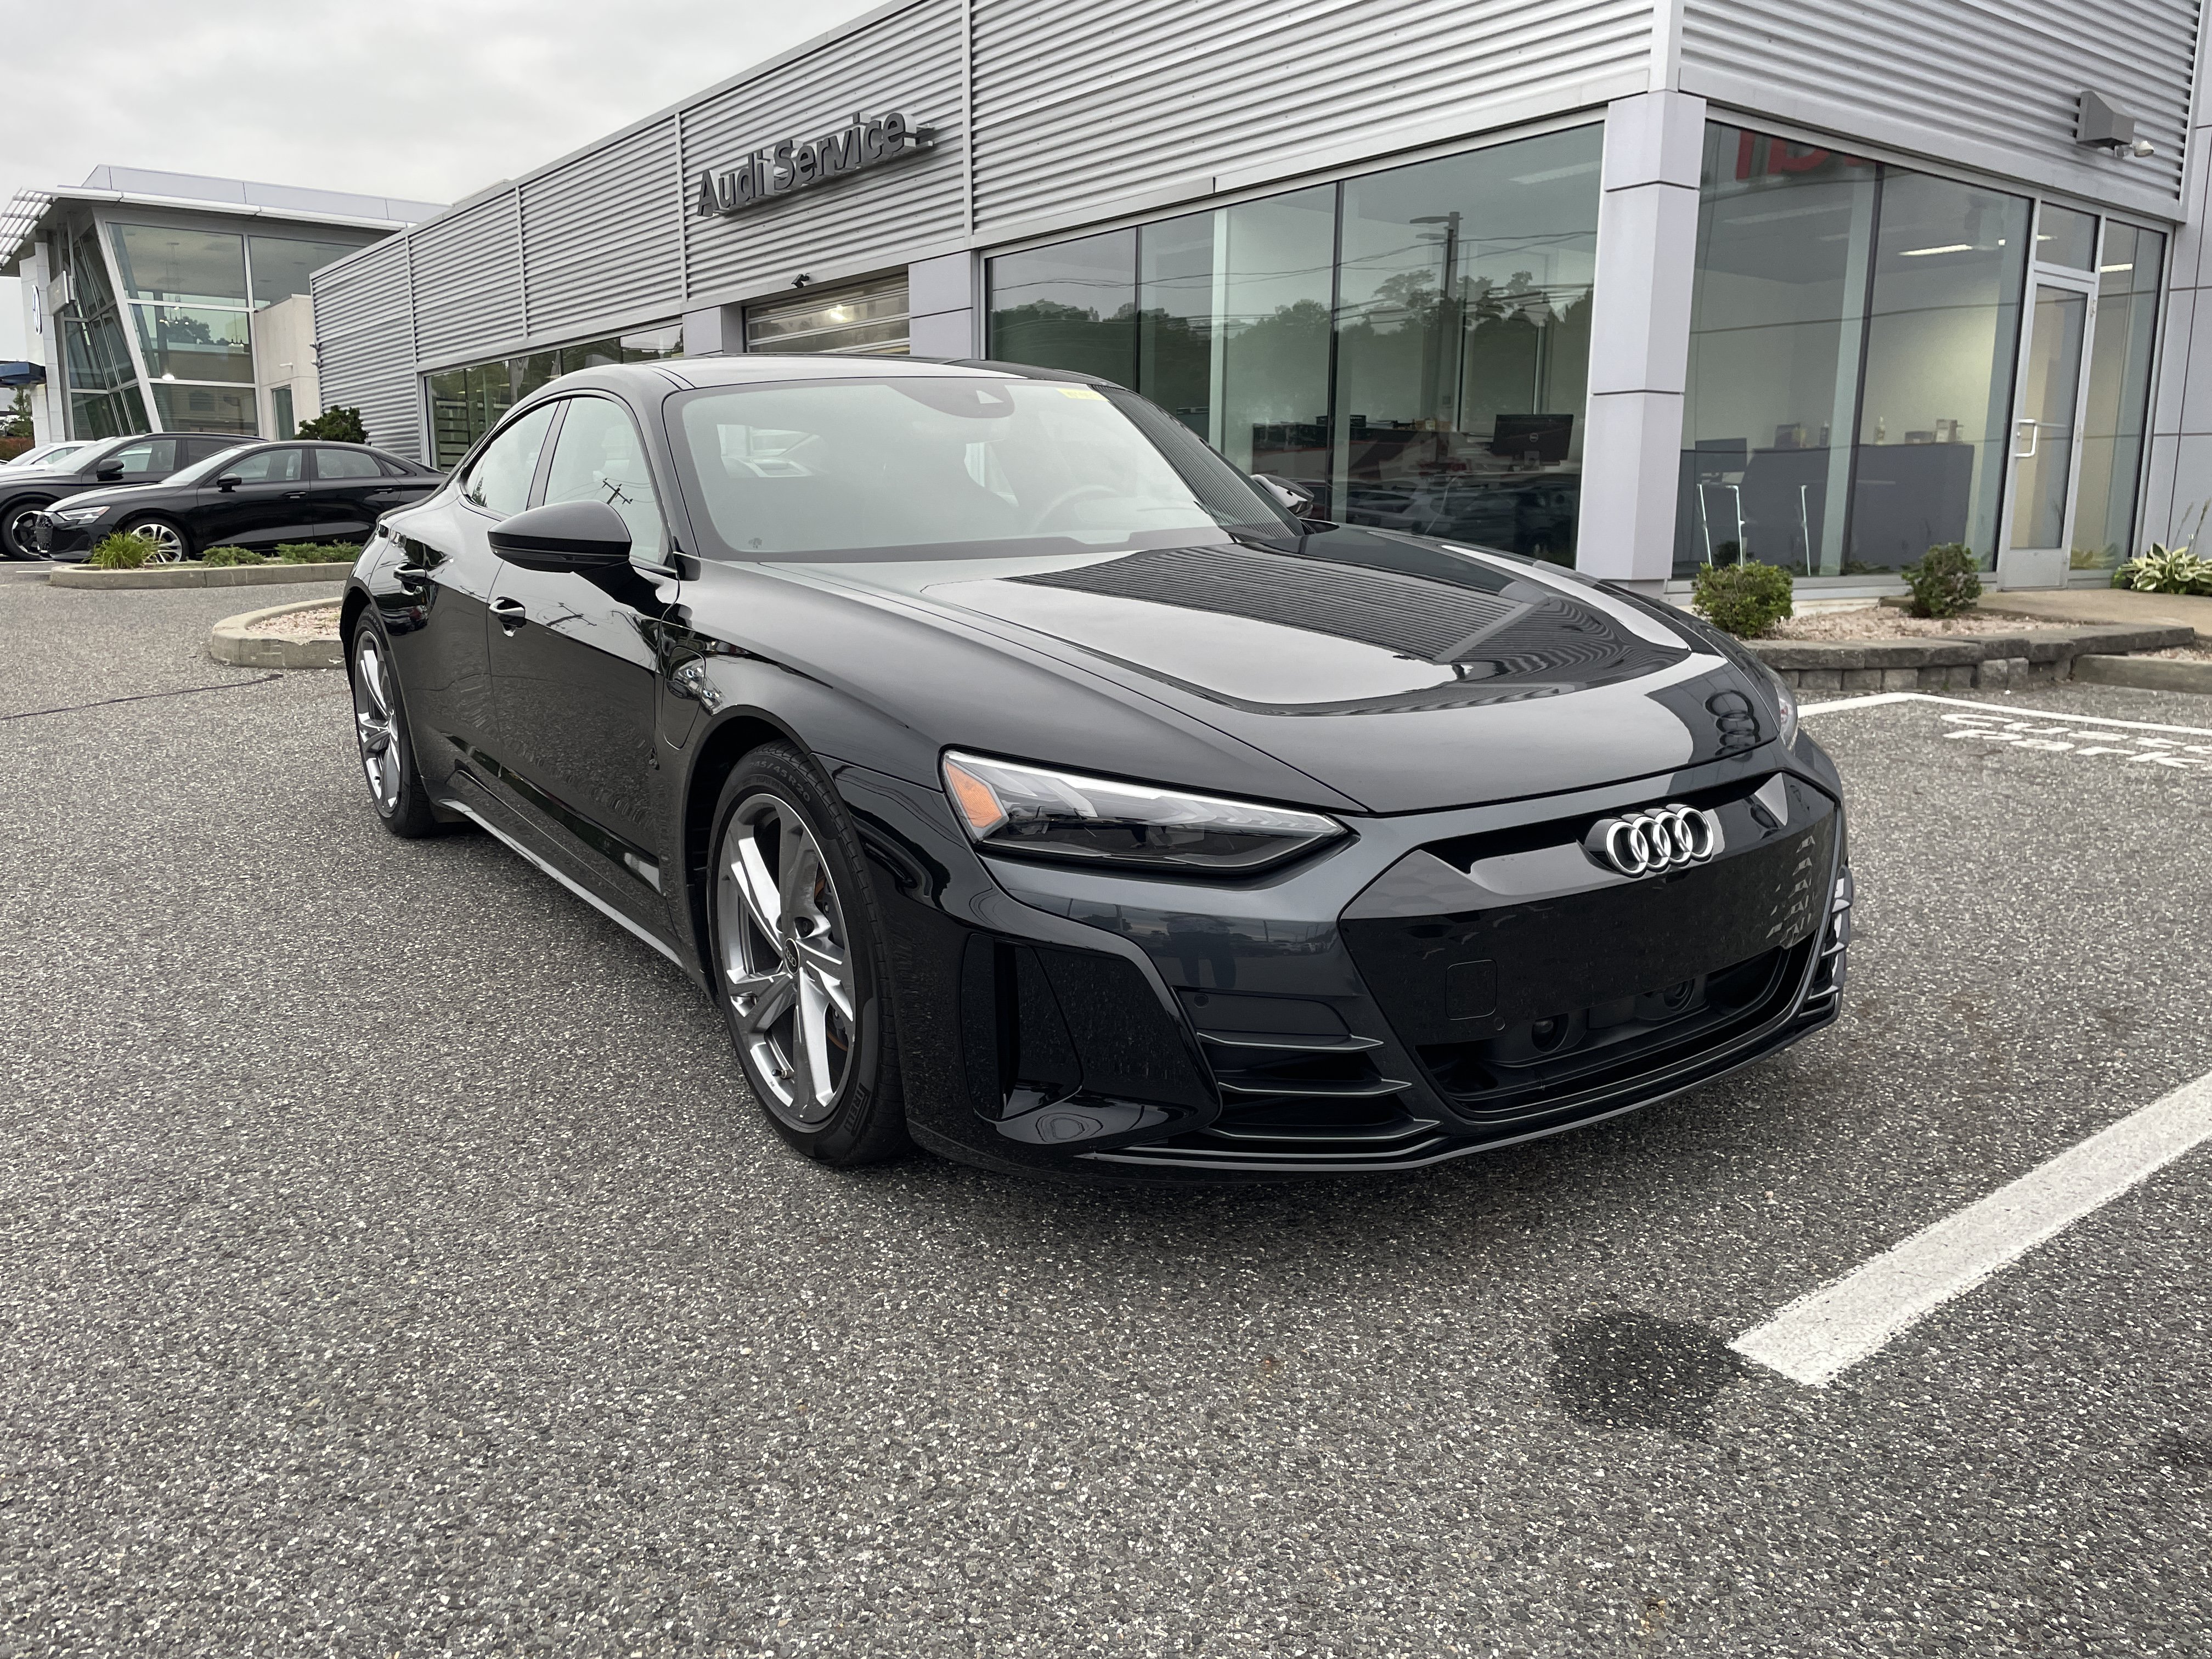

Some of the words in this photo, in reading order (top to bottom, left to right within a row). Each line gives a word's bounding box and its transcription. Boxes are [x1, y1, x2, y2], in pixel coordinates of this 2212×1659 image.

[697, 149, 770, 217] Audi
[774, 112, 911, 190] Service
[844, 1082, 871, 1137] PIRELLI
